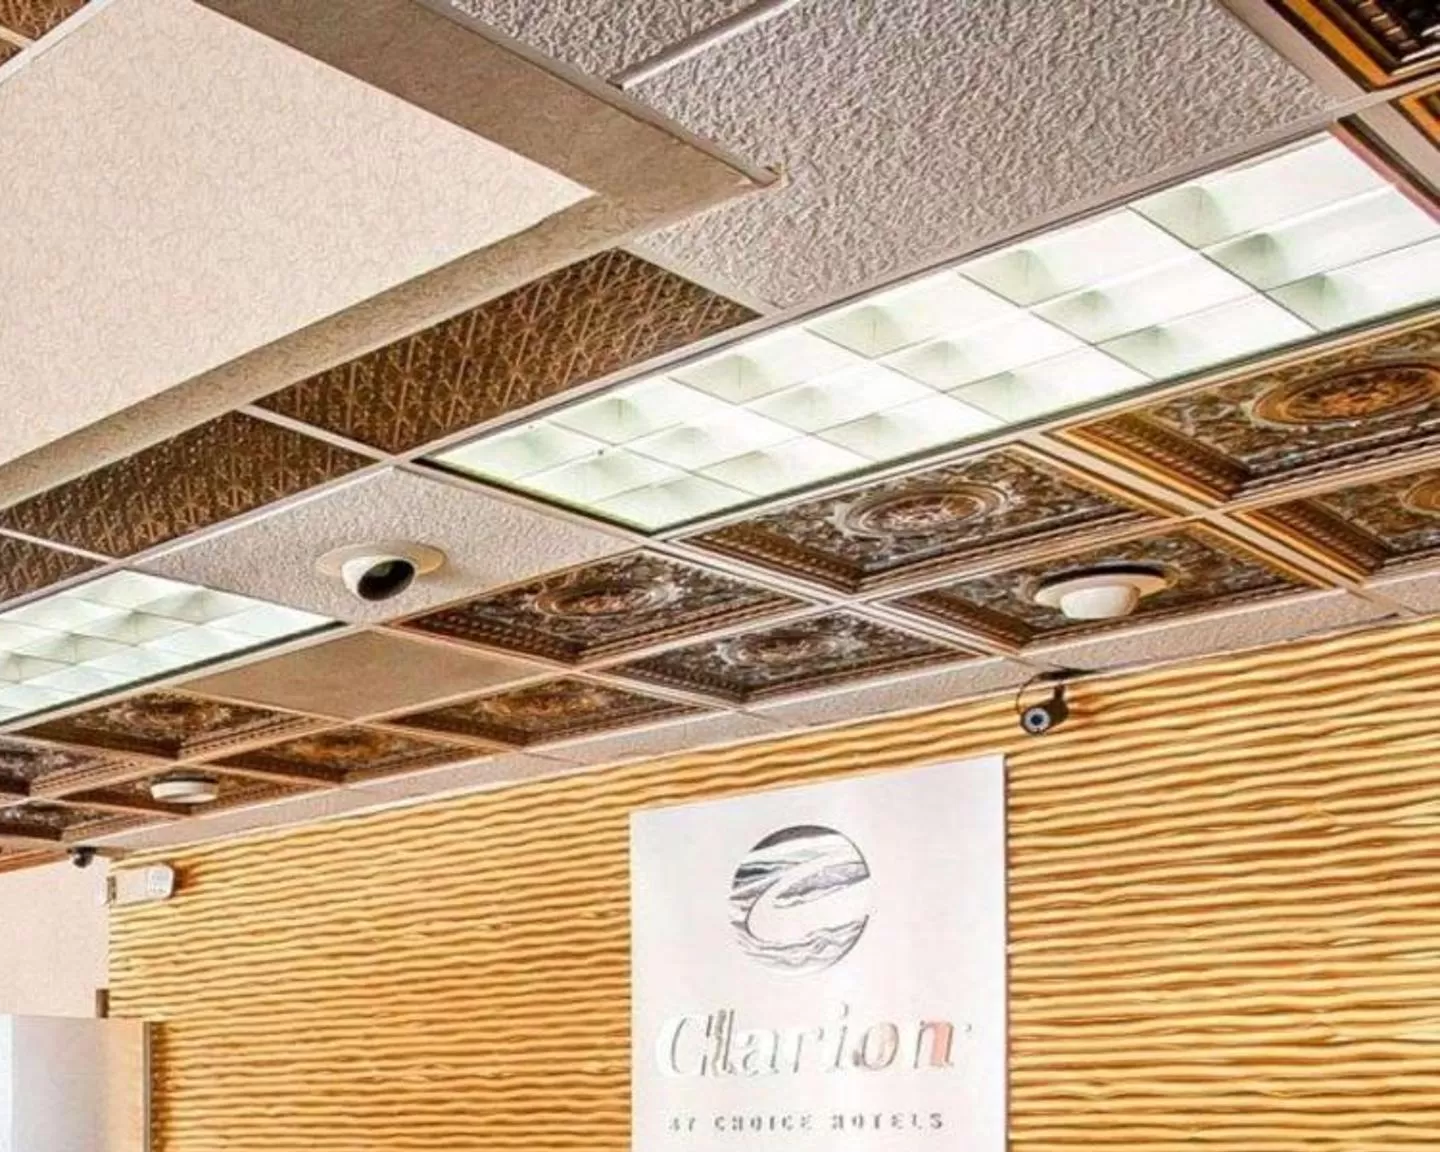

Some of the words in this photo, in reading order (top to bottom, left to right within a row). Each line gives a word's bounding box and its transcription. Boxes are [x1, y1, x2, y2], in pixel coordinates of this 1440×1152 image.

[665, 1002, 958, 1077] Clarion
[713, 1114, 812, 1132] CHOICE
[830, 1112, 943, 1131] HOTELS
